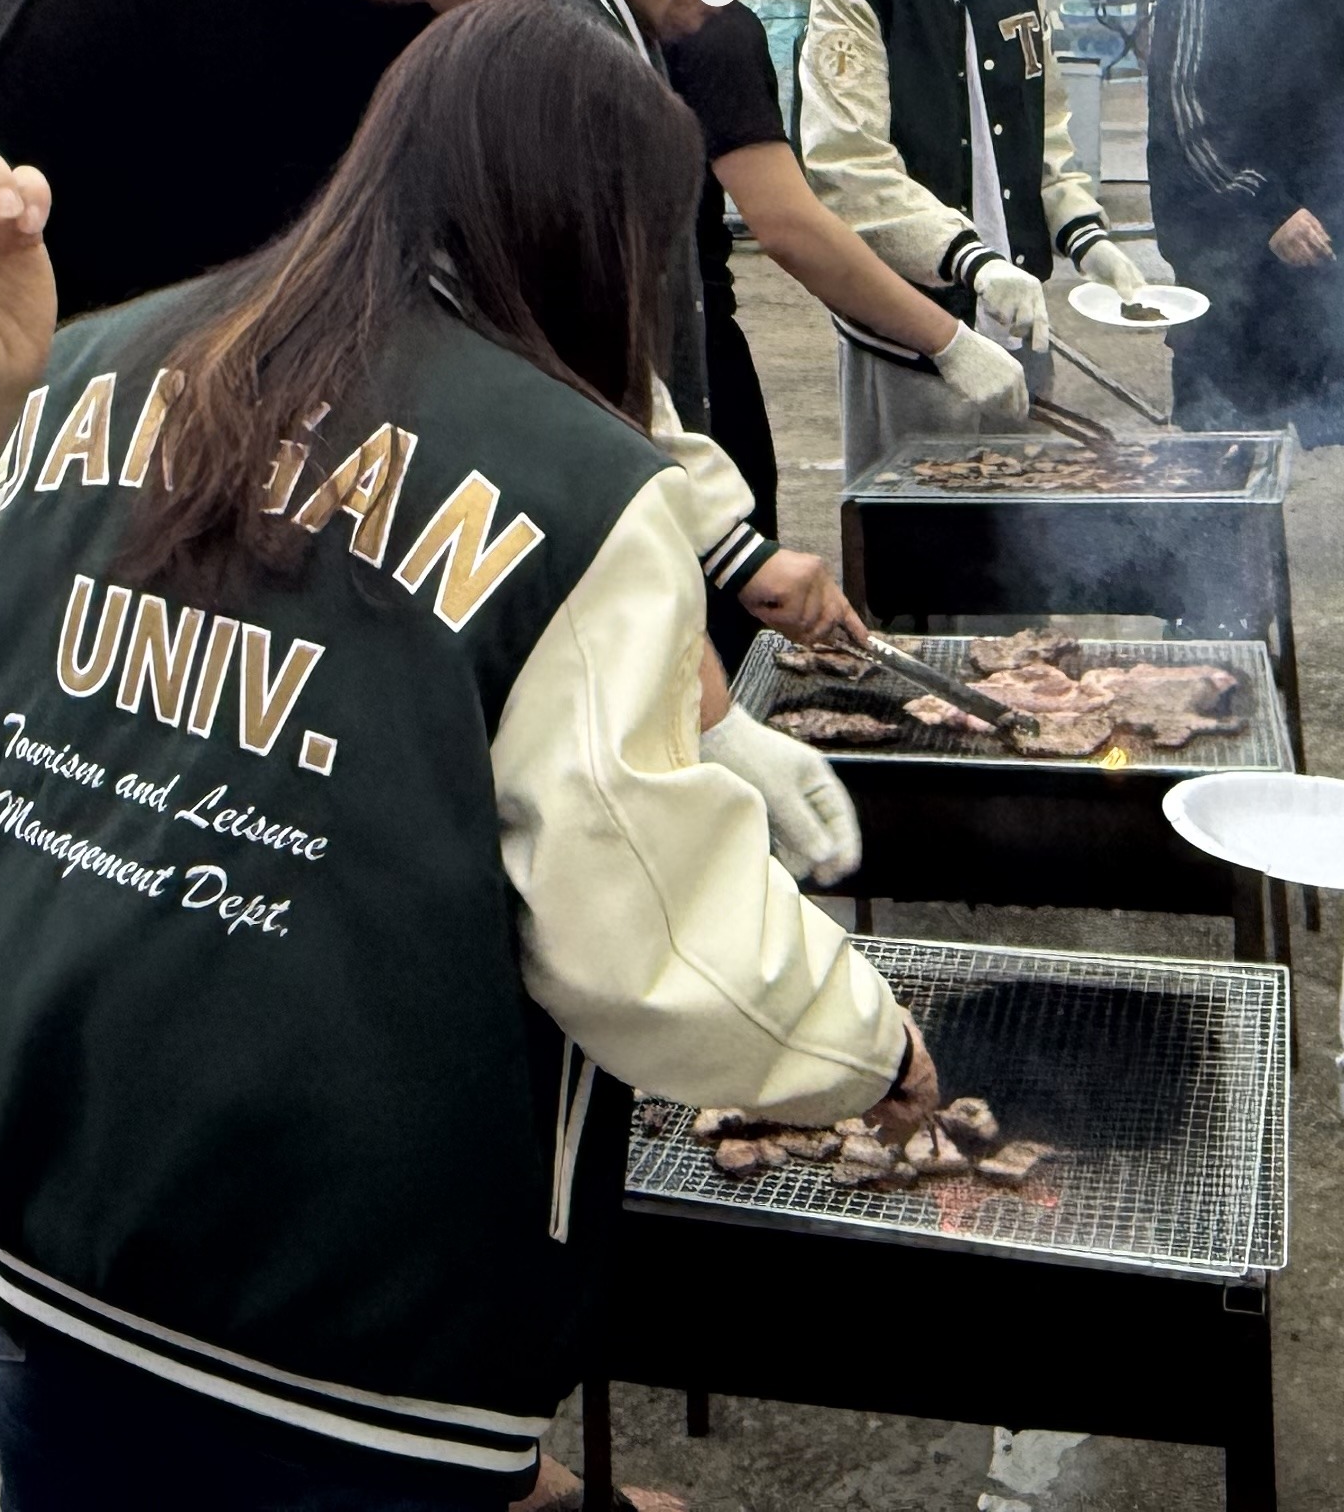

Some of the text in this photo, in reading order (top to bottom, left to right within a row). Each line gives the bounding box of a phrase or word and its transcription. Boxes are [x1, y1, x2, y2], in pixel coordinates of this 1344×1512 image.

[998, 10, 1042, 79] T
[57, 574, 338, 776] UNIV.
[3, 713, 329, 861] Tourism and Leisure
[181, 864, 292, 937] Dept.
